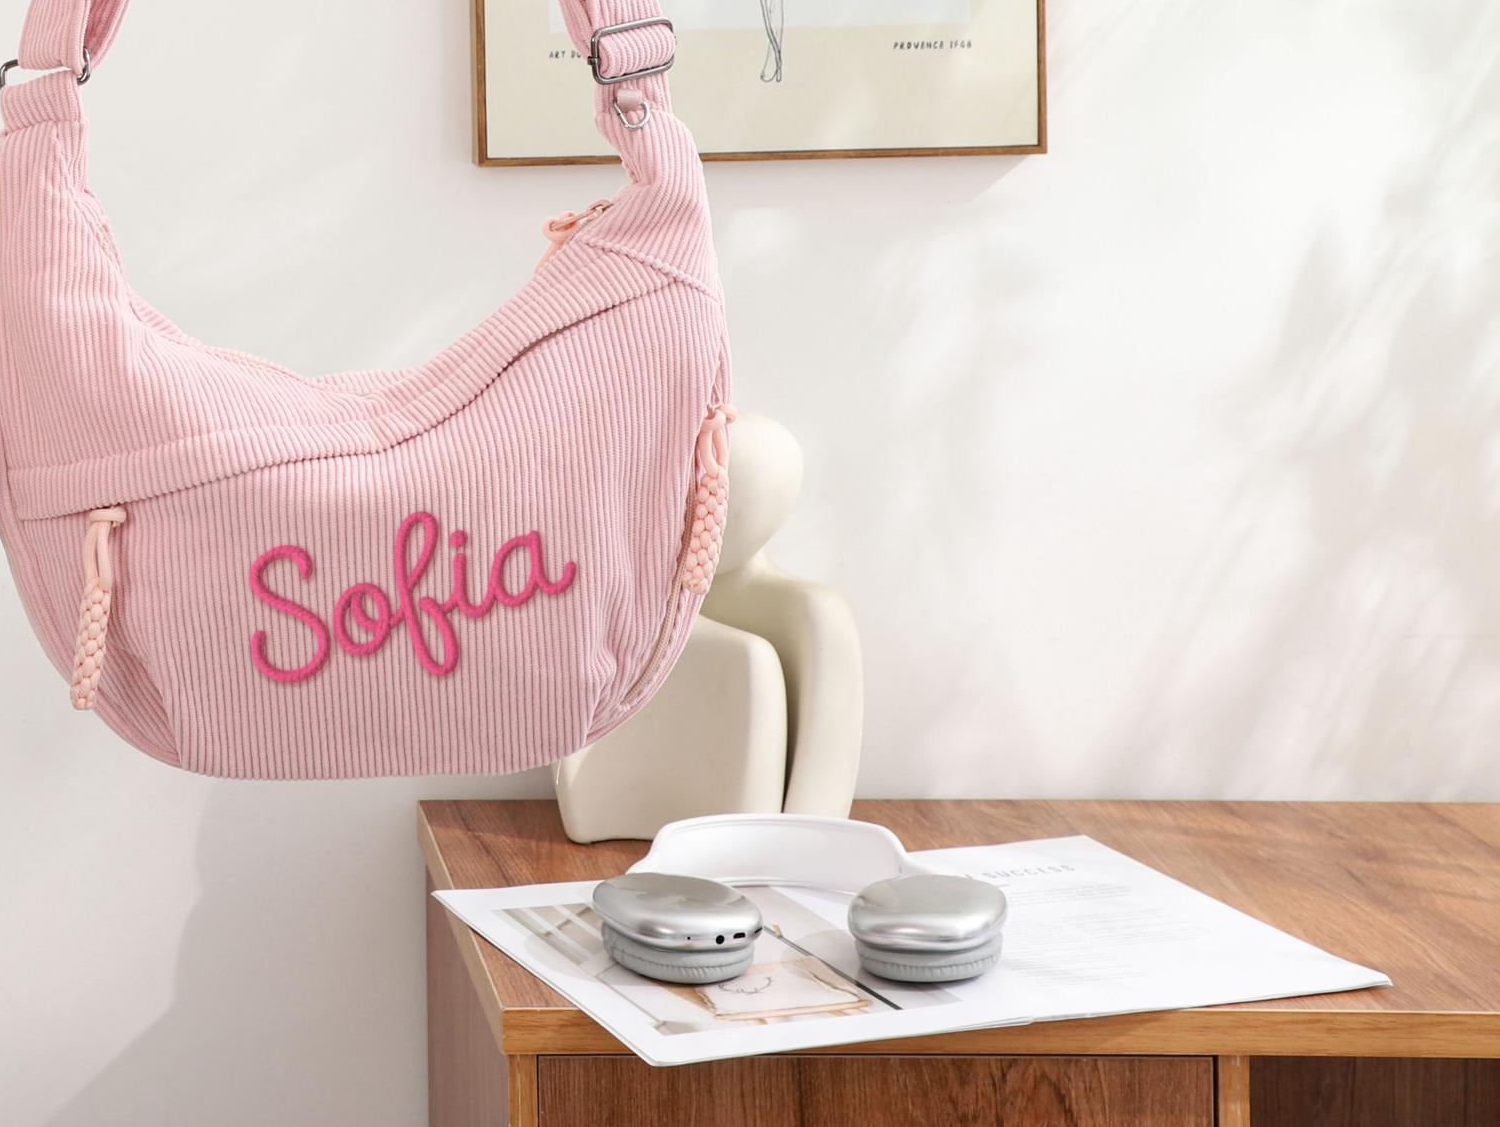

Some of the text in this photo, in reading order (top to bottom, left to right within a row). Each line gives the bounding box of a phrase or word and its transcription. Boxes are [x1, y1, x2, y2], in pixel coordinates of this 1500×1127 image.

[892, 40, 945, 50] PROVENCE
[548, 50, 566, 60] ART
[250, 511, 577, 684] Sofia
